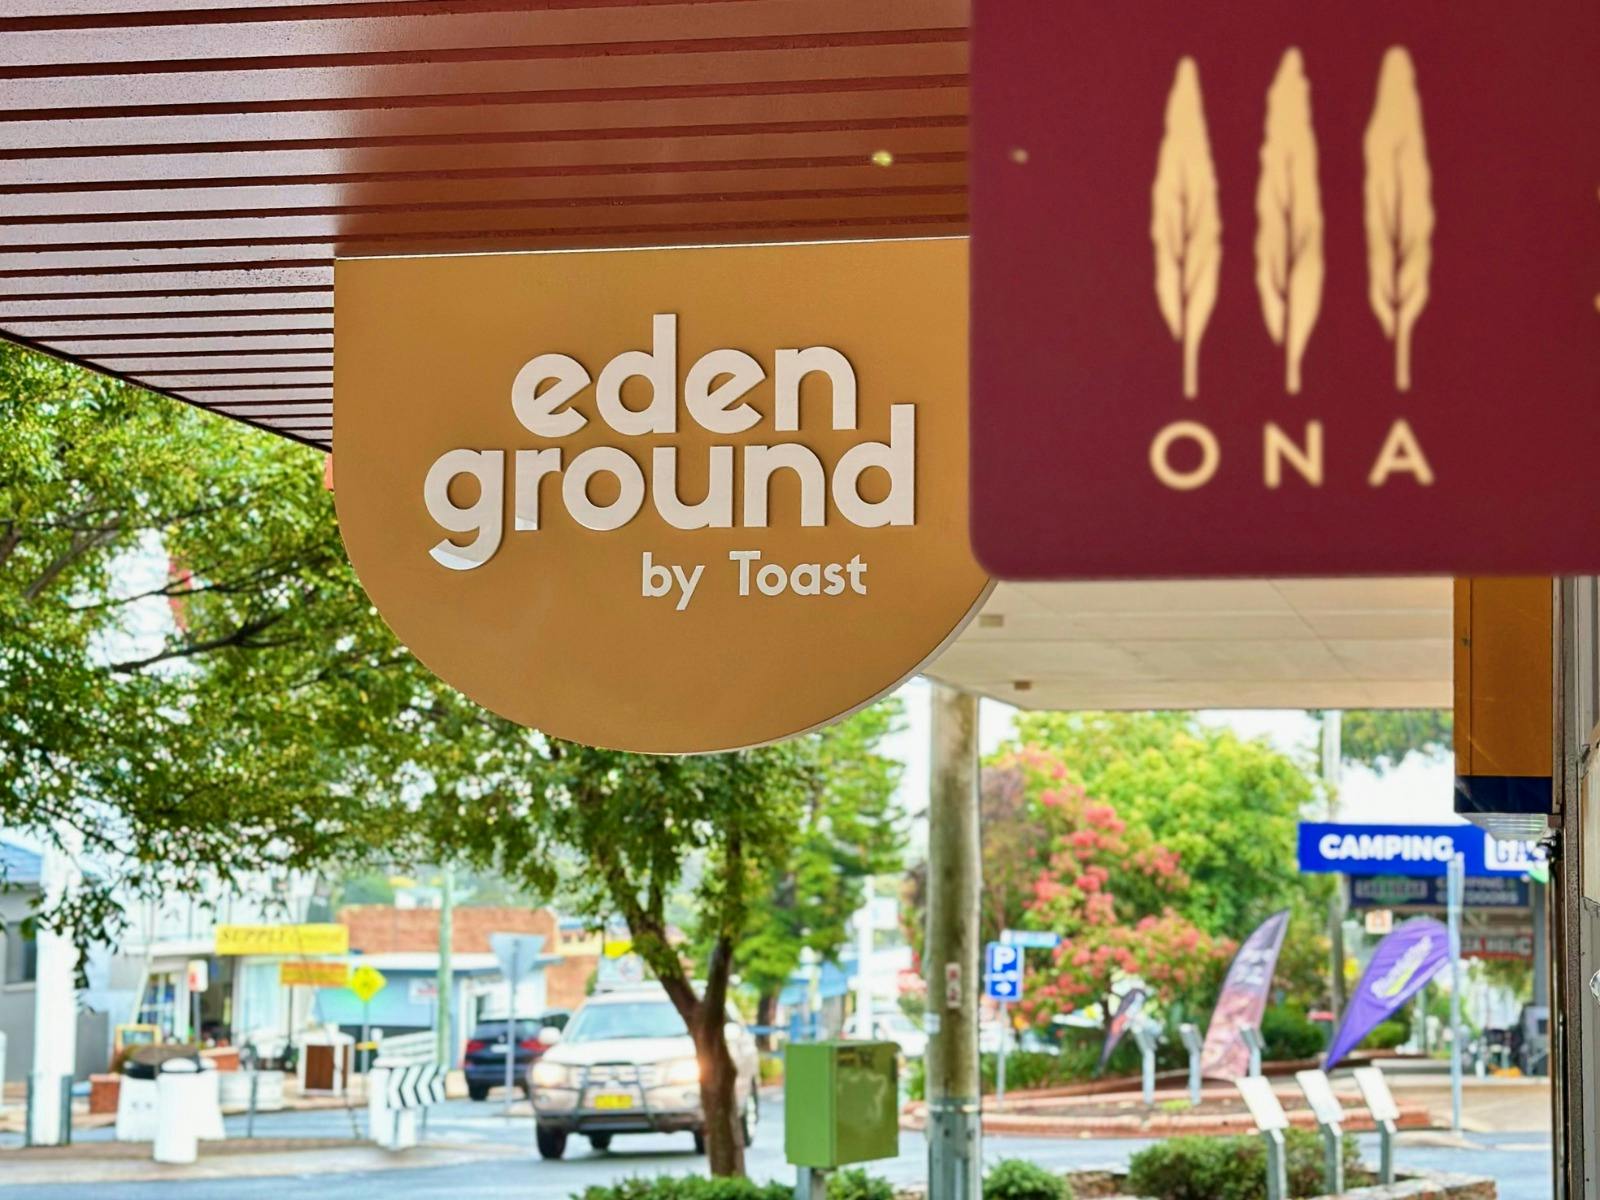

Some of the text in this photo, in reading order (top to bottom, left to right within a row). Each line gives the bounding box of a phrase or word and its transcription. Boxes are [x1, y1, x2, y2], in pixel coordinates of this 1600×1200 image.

[511, 313, 857, 438] eden
[423, 403, 916, 571] ground
[1150, 420, 1434, 490] ONA
[641, 550, 867, 611] by Toast
[1319, 833, 1455, 862] CAMPING
[993, 946, 1016, 972] P
